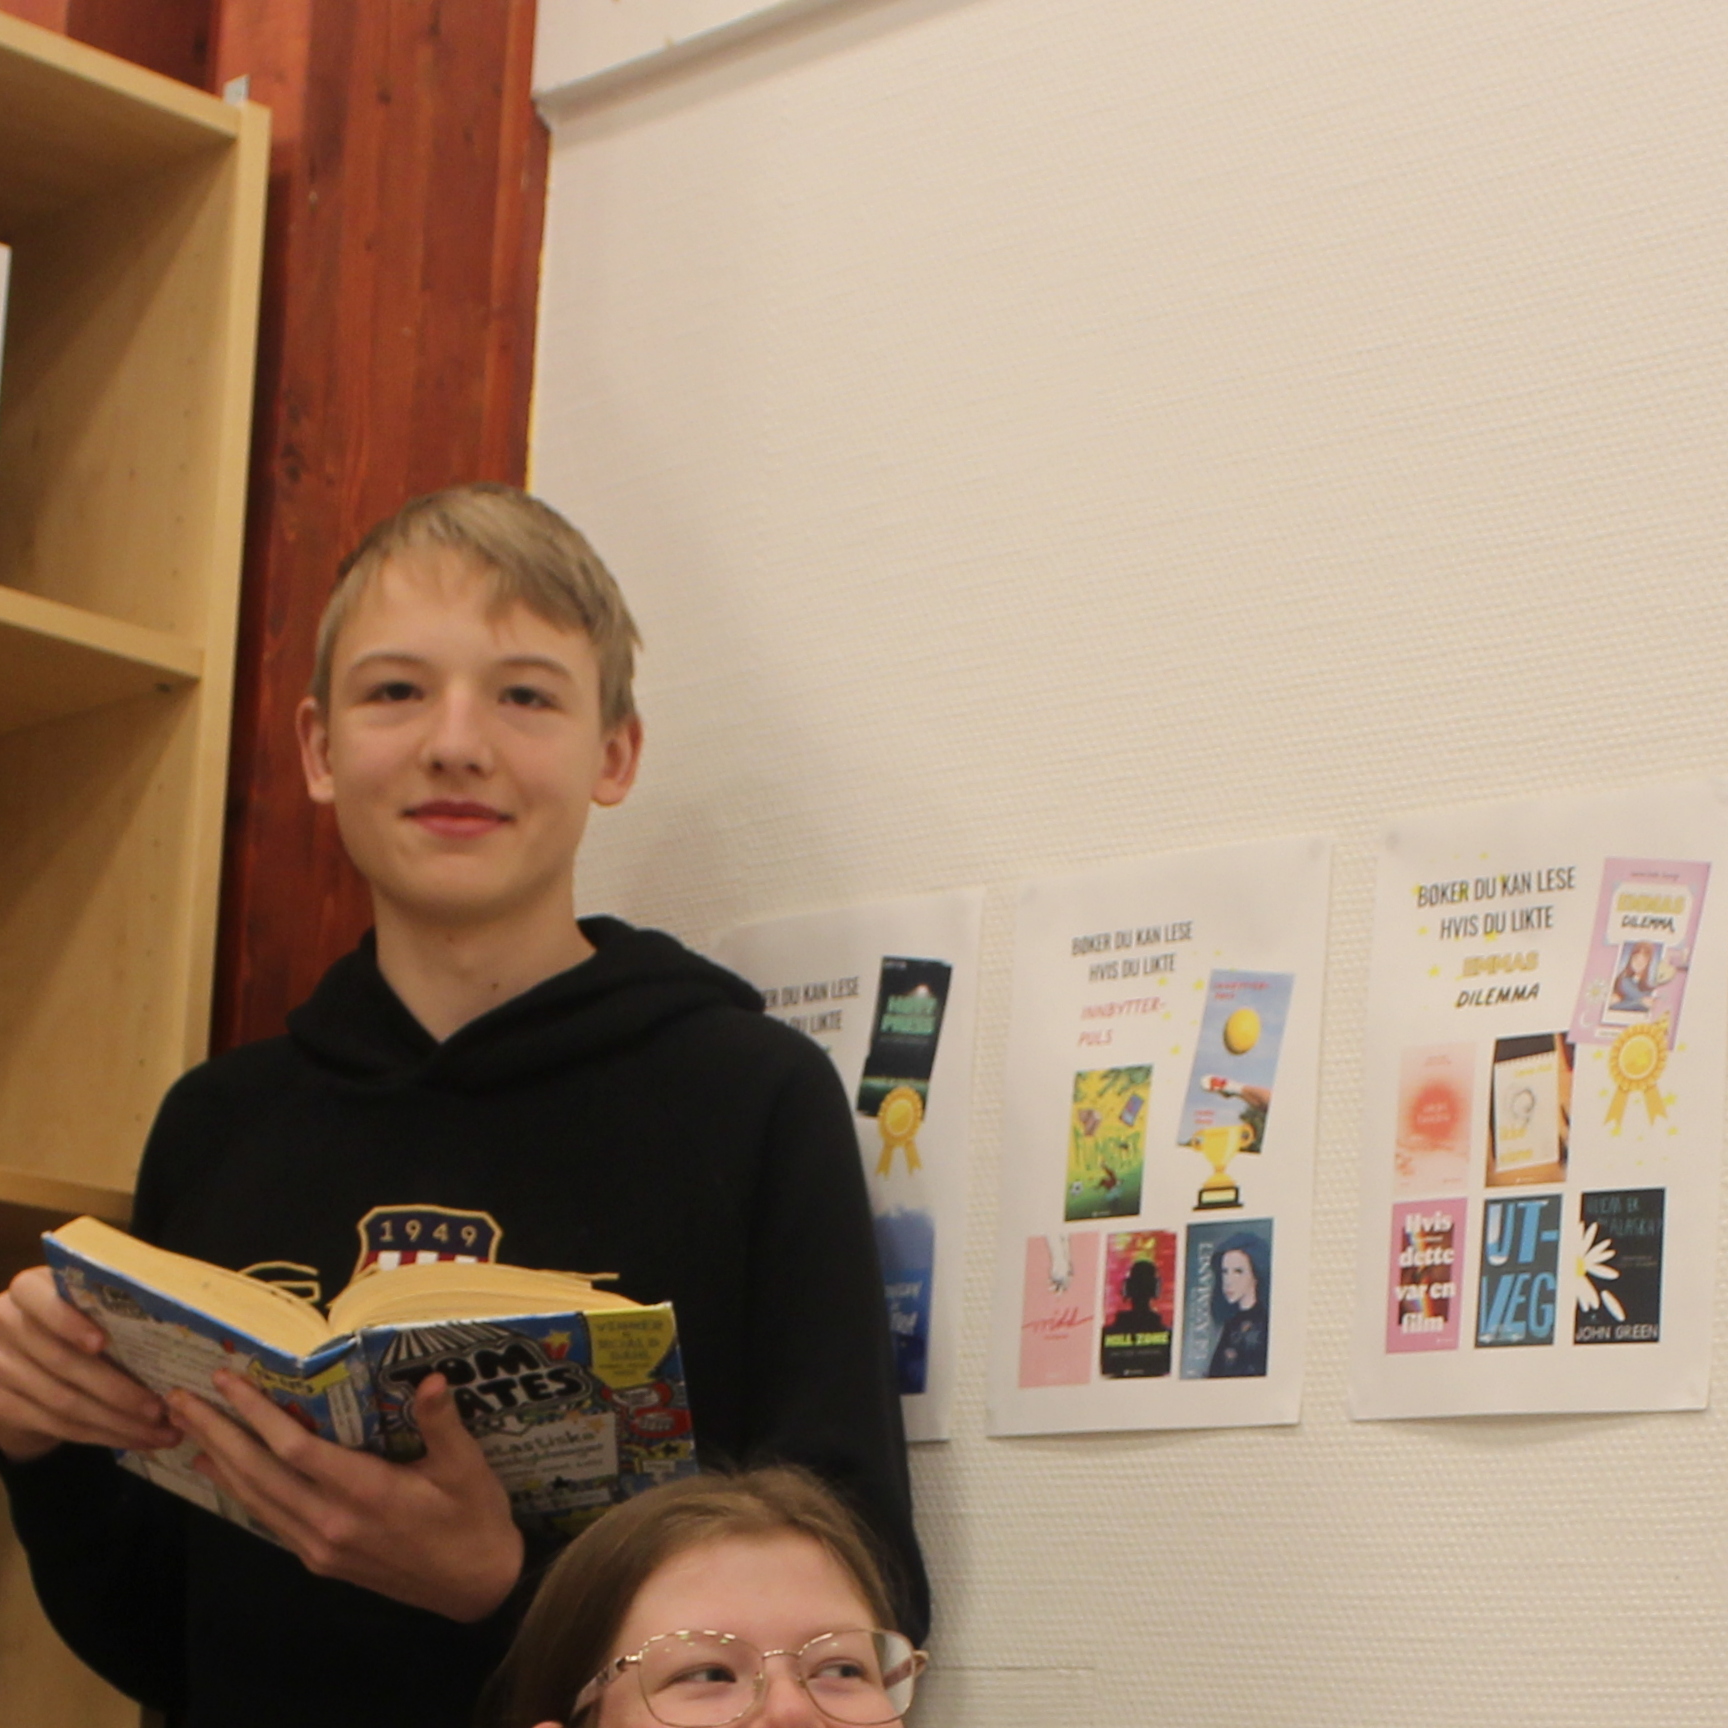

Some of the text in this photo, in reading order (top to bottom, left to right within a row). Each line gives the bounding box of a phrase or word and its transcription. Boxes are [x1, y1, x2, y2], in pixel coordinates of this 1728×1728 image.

[1416, 866, 1577, 909] BØKER DU KAN LESE
[1438, 906, 1555, 941] HVIS DU LIKTE
[1071, 920, 1195, 957] BØKER DU KAN LESE
[1088, 958, 1120, 983] HVIS
[1121, 957, 1139, 979] DU
[1454, 982, 1541, 1010] DILEMMA
[378, 1219, 479, 1246] 1949
[1404, 1211, 1455, 1236] Hvis
[1486, 1200, 1560, 1266] UT-
[1398, 1244, 1456, 1268] dette
[1394, 1277, 1457, 1303] var en
[1480, 1271, 1558, 1343] VEG
[1400, 1312, 1445, 1336] film
[1576, 1323, 1659, 1342] JOHN GREEN
[390, 1342, 541, 1388] TOM
[453, 1367, 583, 1419] ATES
